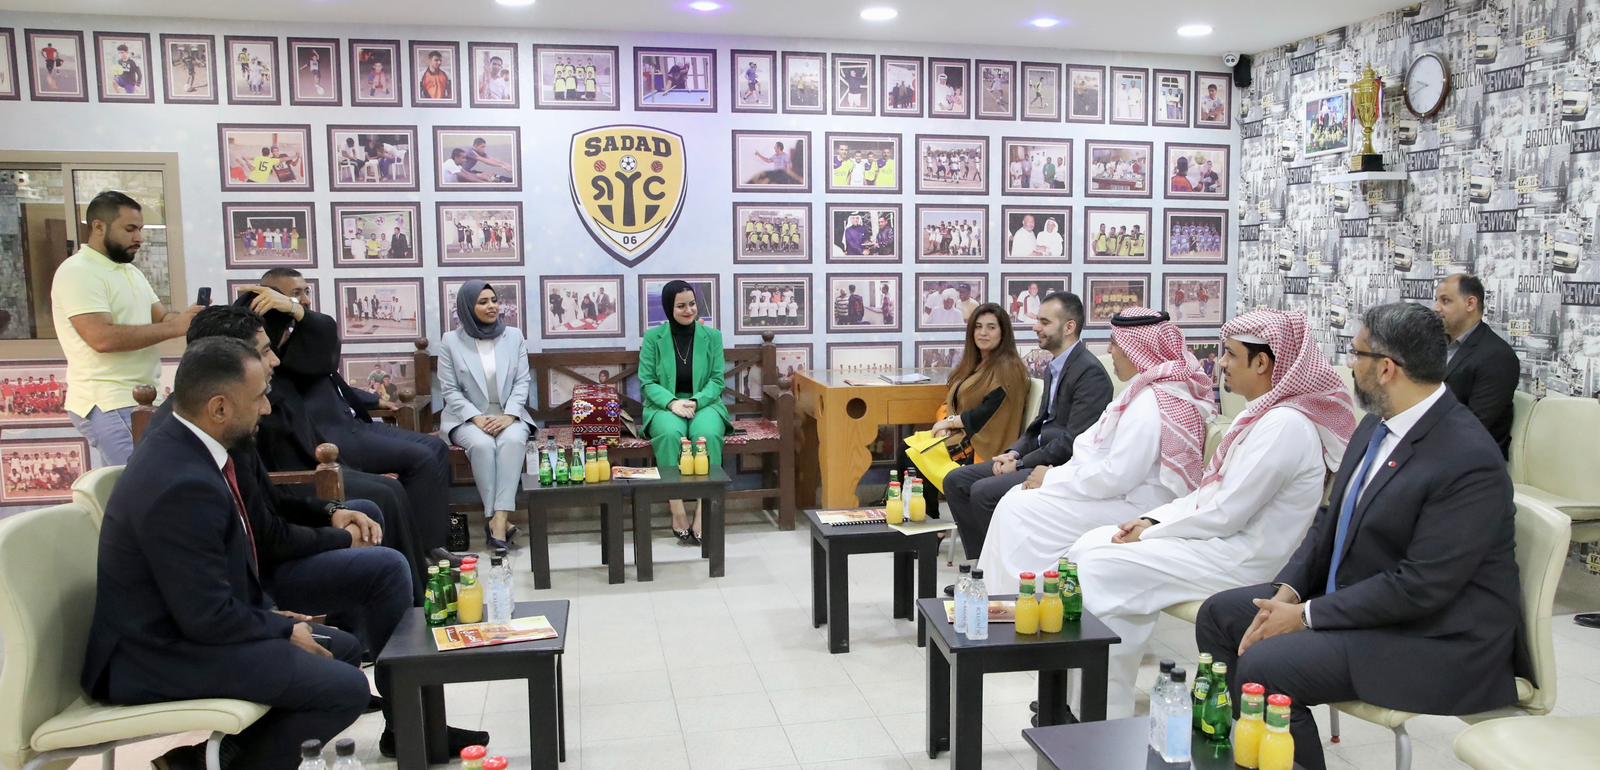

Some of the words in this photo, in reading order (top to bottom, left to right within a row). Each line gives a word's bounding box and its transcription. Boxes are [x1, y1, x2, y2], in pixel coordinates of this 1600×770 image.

[1377, 18, 1411, 43] BROOKLYN
[584, 135, 672, 157] SADAD
[1526, 124, 1572, 148] BROOKLYN
[1441, 205, 1478, 225] BROOKLYN
[622, 236, 637, 245] 06
[1518, 275, 1563, 295] BROOKLYN
